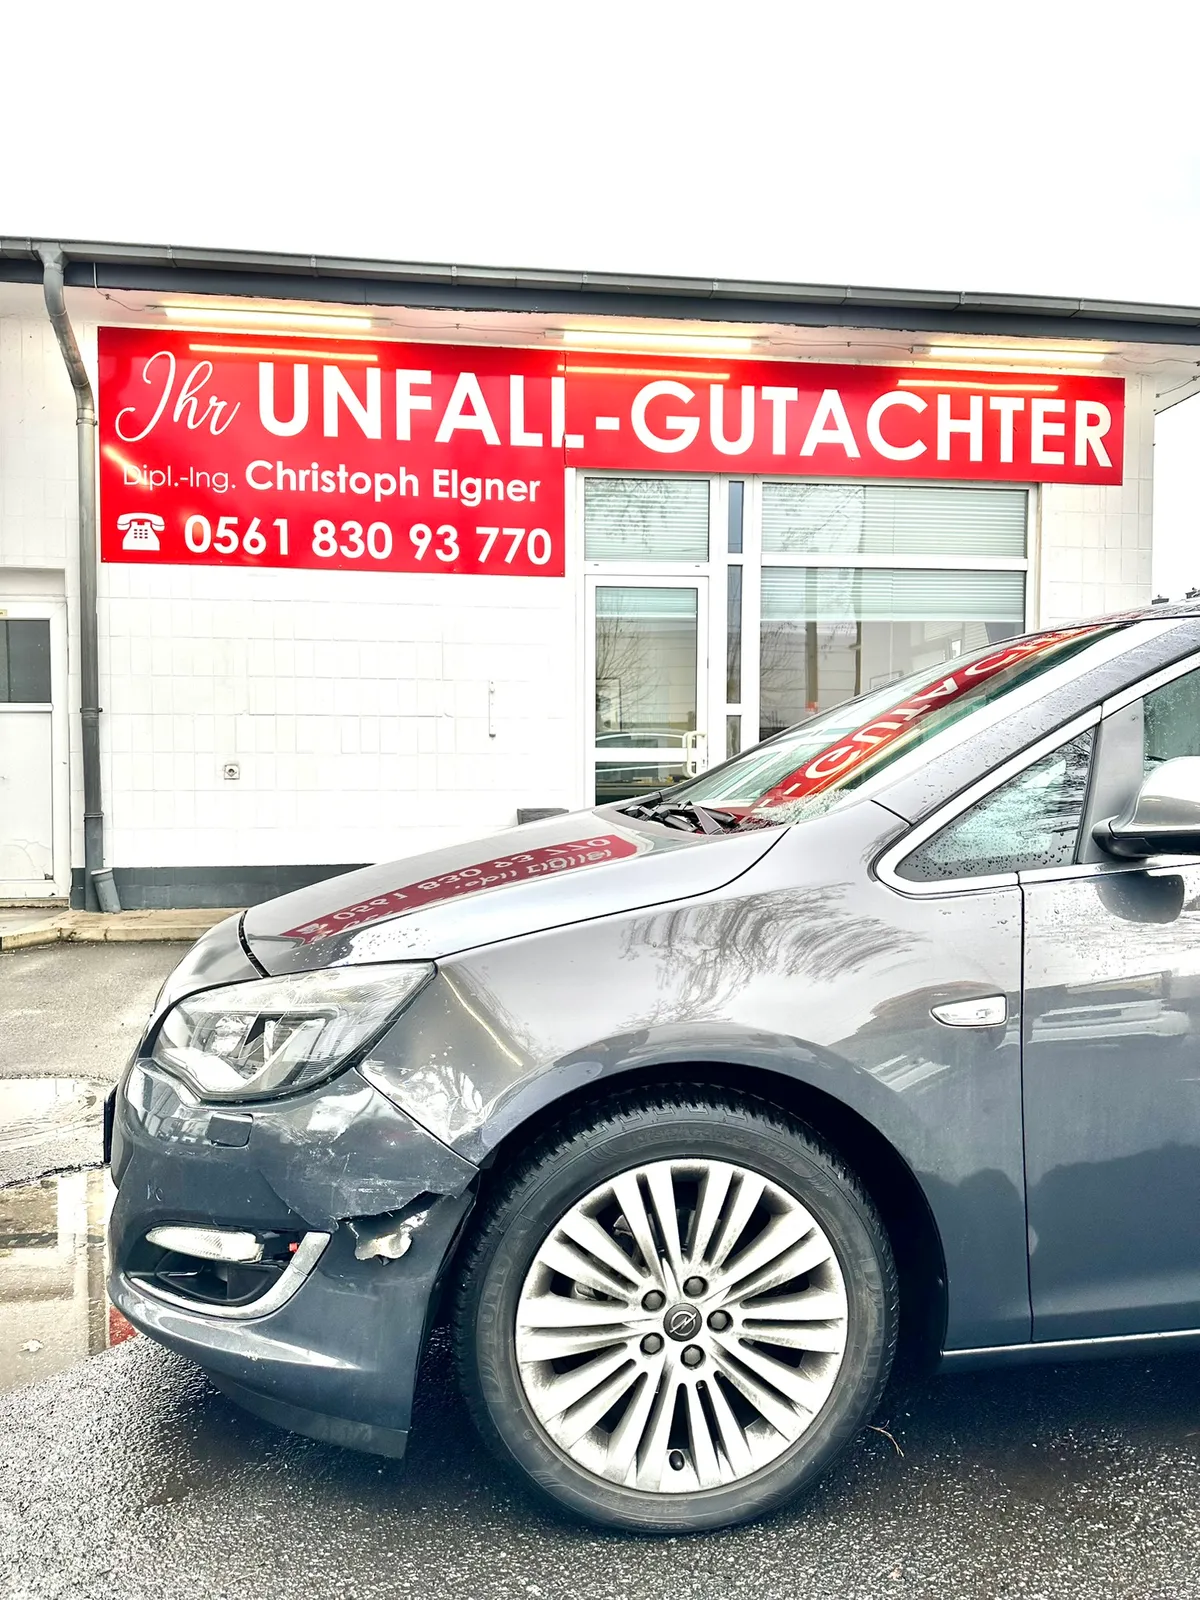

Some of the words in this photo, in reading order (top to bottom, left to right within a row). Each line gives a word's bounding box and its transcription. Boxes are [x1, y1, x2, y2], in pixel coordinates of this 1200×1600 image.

[123, 464, 236, 494] Dipl.-Ing.
[245, 460, 419, 502] Christoph
[433, 469, 541, 507] Elgner
[184, 514, 289, 555] 0561
[312, 519, 393, 560] 830
[409, 523, 460, 563] 93
[475, 526, 552, 565] 770
